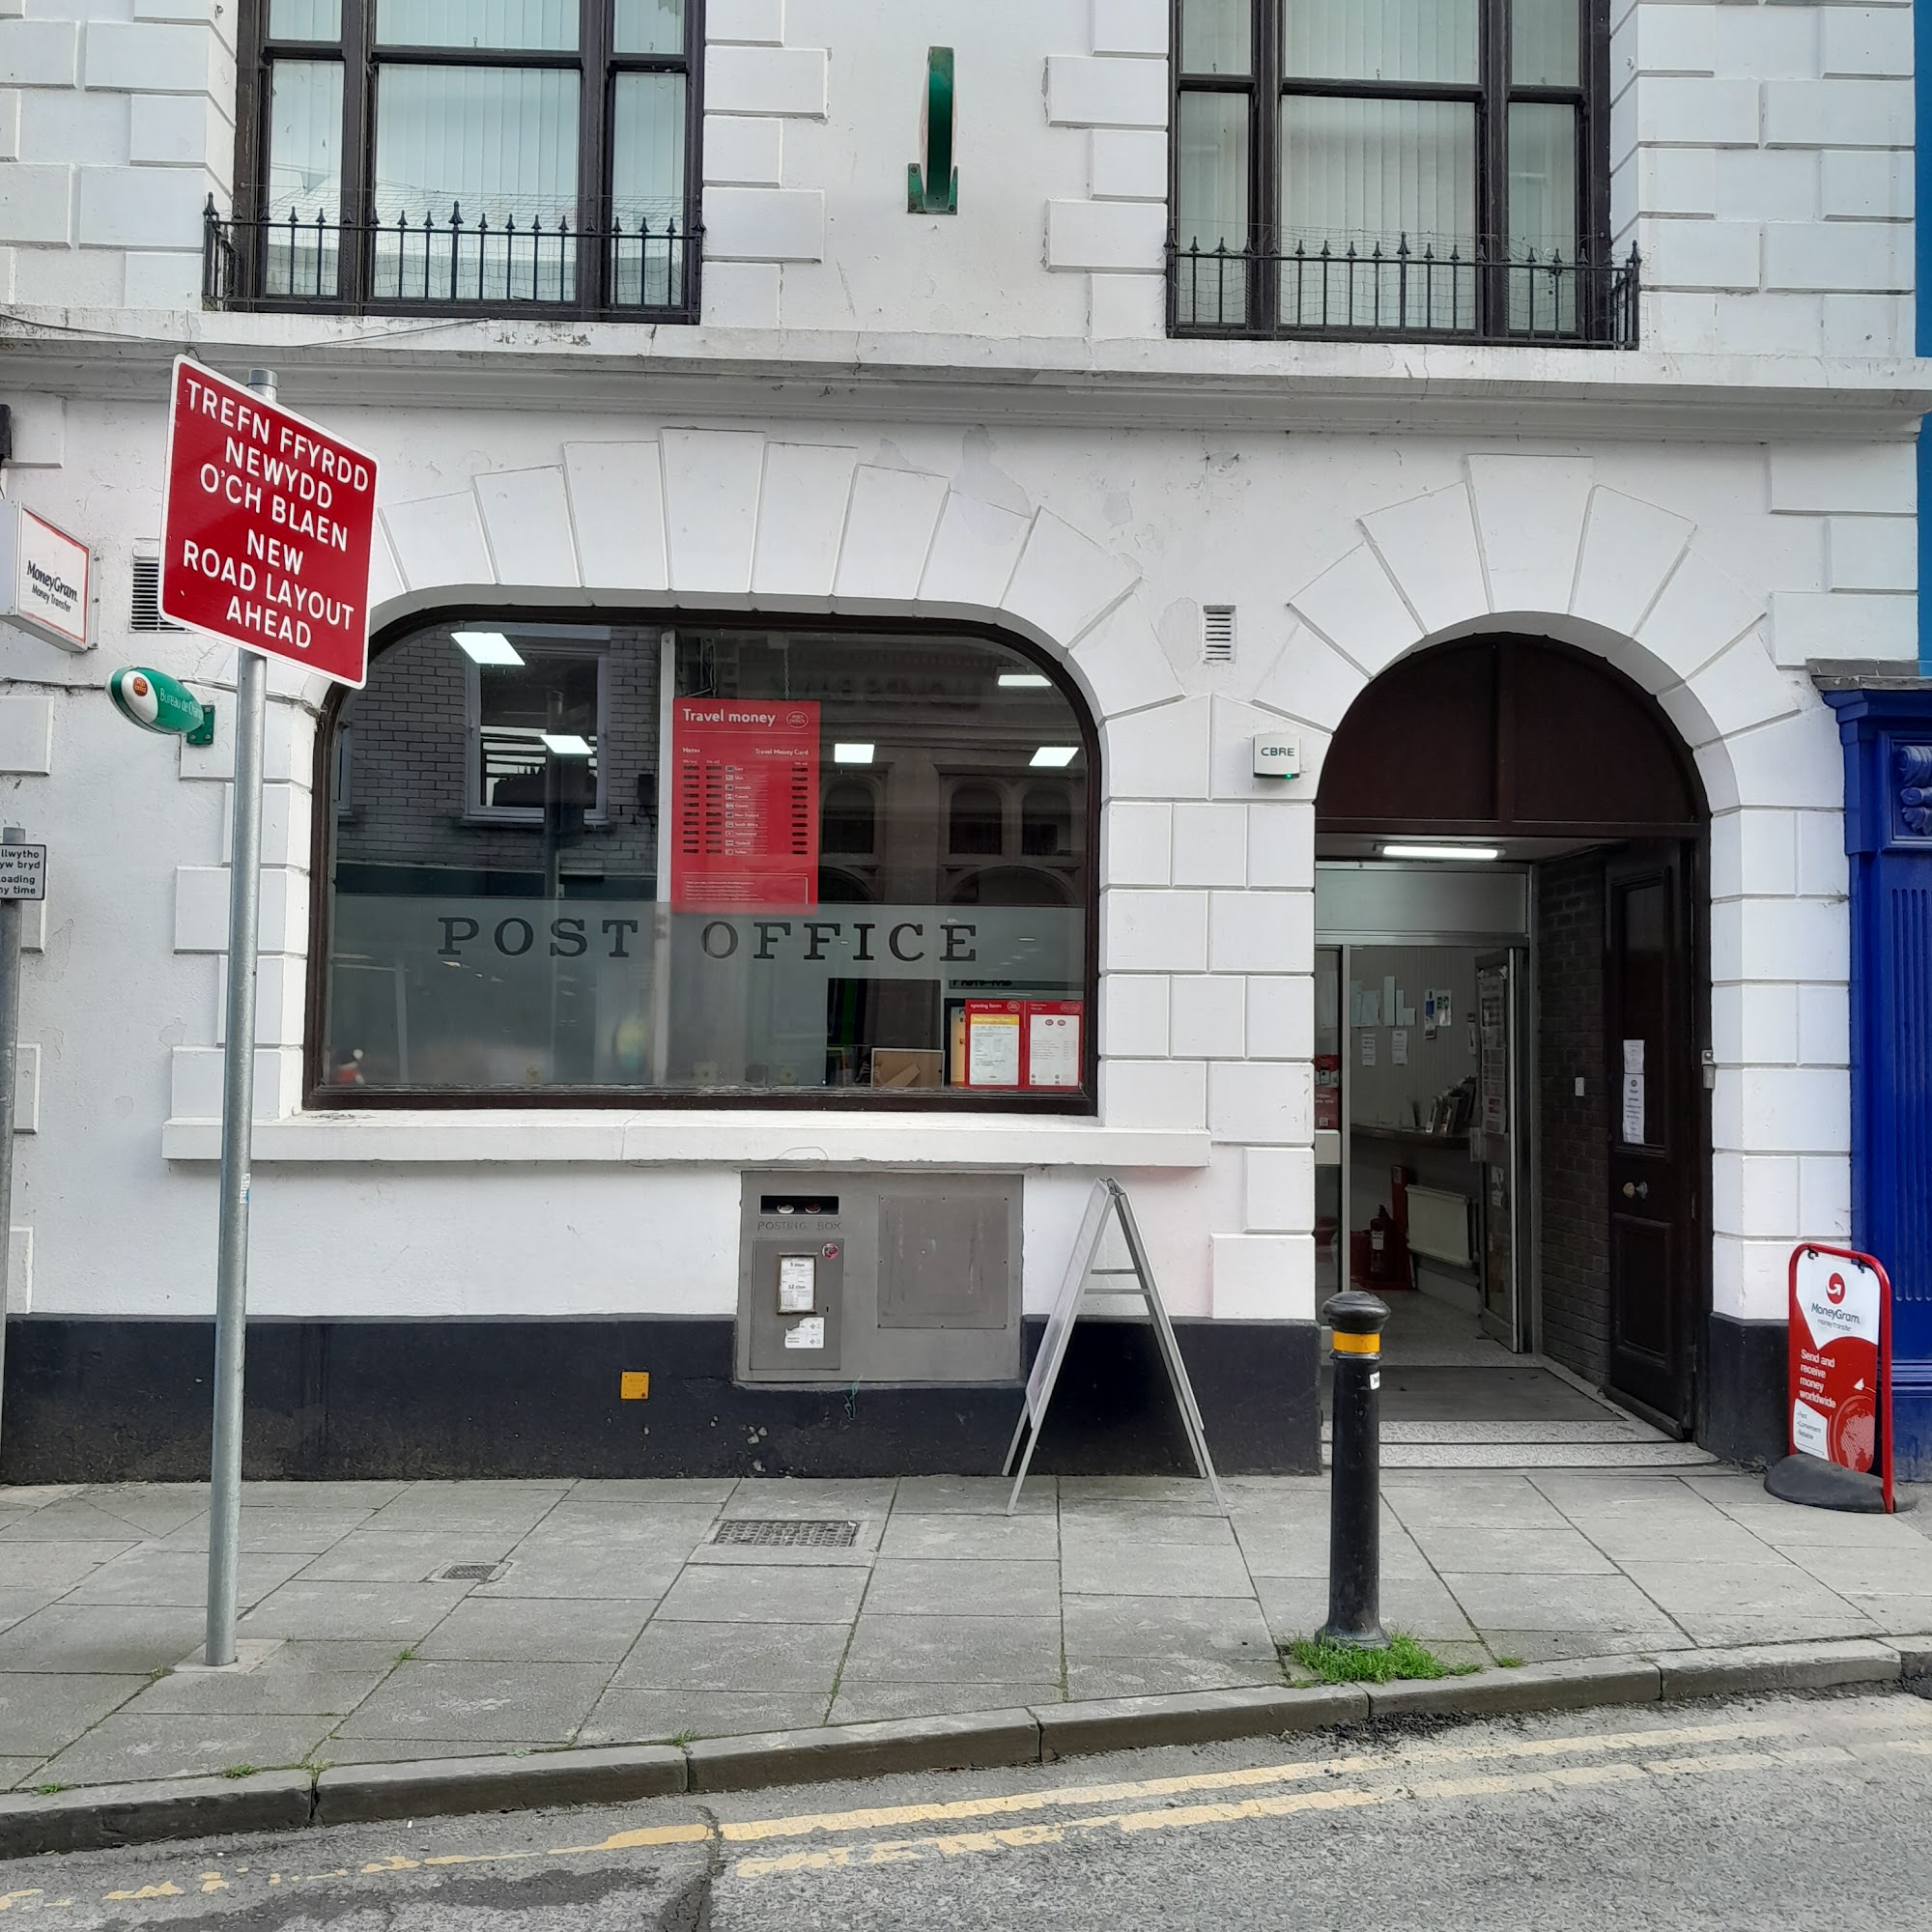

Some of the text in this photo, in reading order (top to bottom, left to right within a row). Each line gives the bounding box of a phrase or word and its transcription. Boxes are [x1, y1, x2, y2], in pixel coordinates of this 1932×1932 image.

[185, 378, 369, 493] TREFN FFYRDD
[225, 436, 333, 509] NEWYDD
[200, 463, 348, 553] O'CH BLAEN
[247, 529, 304, 576] NEW
[183, 539, 355, 631] ROAD LAYOUT
[32, 582, 71, 612] Money Transfer
[226, 595, 312, 649] AHEAD
[159, 687, 182, 709] Bureau
[682, 708, 777, 727] Travel money
[1261, 747, 1295, 756] CBRE
[1, 848, 40, 860] llwytho
[17, 860, 41, 871] bryd
[0, 874, 36, 886] oading
[14, 885, 36, 895] time
[437, 916, 977, 962] POST OFFICE
[757, 1221, 841, 1231] POSTING BOX
[1801, 1349, 1835, 1368] Send and
[1800, 1364, 1827, 1378] receive
[1799, 1377, 1824, 1393] money
[1799, 1390, 1836, 1409] worldwide
